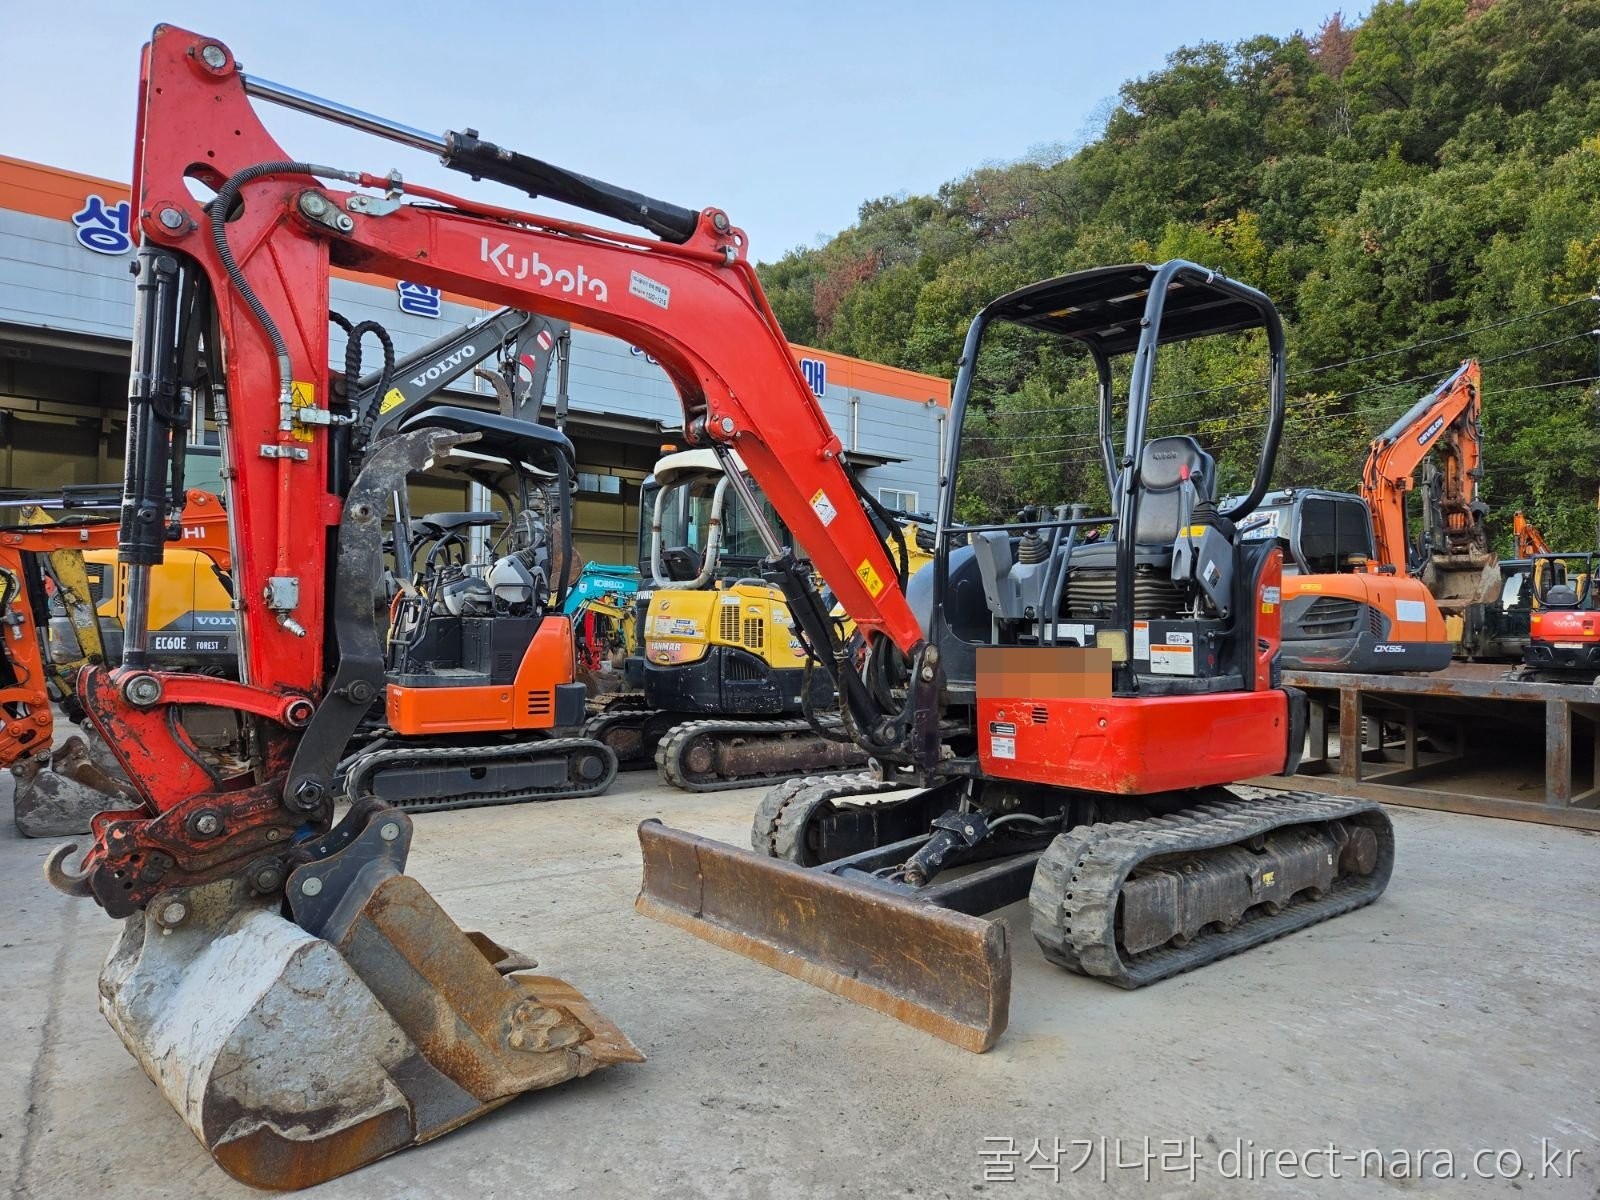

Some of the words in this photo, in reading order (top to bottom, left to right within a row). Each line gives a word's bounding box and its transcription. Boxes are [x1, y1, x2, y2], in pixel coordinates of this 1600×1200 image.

[73, 196, 132, 254] 성
[480, 236, 608, 302] Kubota
[409, 345, 475, 387] VOLVO
[593, 579, 625, 589] KOBELCO
[155, 637, 187, 650] EC60E
[196, 641, 219, 650] FOREST
